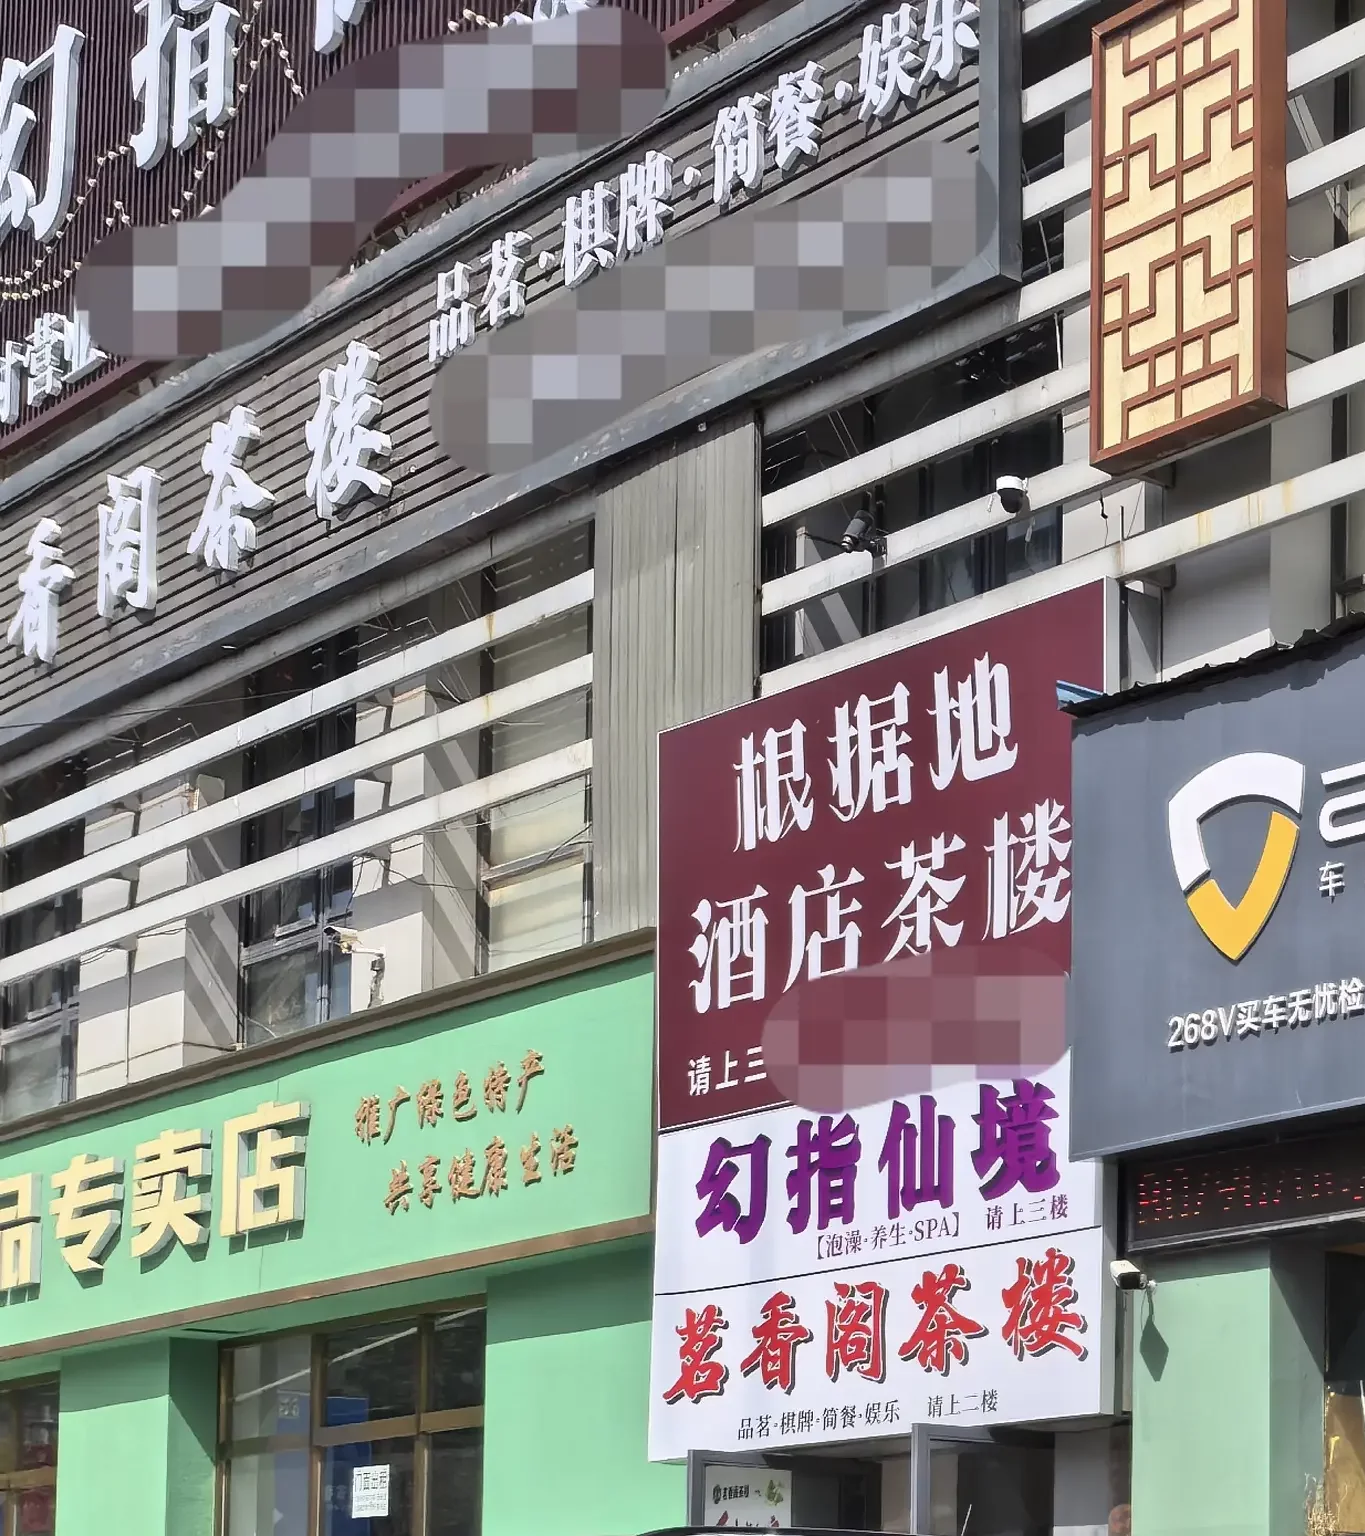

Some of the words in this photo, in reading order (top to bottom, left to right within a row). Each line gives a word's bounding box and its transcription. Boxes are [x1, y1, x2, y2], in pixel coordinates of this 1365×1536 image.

[731, 651, 1018, 853] 根据地
[687, 798, 1073, 1014] 酒店茶楼
[1166, 977, 1365, 1049] 268V买车无忧检
[354, 1048, 546, 1145] 推广绿色特产
[382, 1123, 578, 1214] 共享健康生活
[694, 1079, 1062, 1246] 幻指仙境
[984, 1194, 1069, 1231] 请上三楼
[662, 1247, 1090, 1406] 茗香阁茶楼
[926, 1389, 999, 1419] 请上二楼
